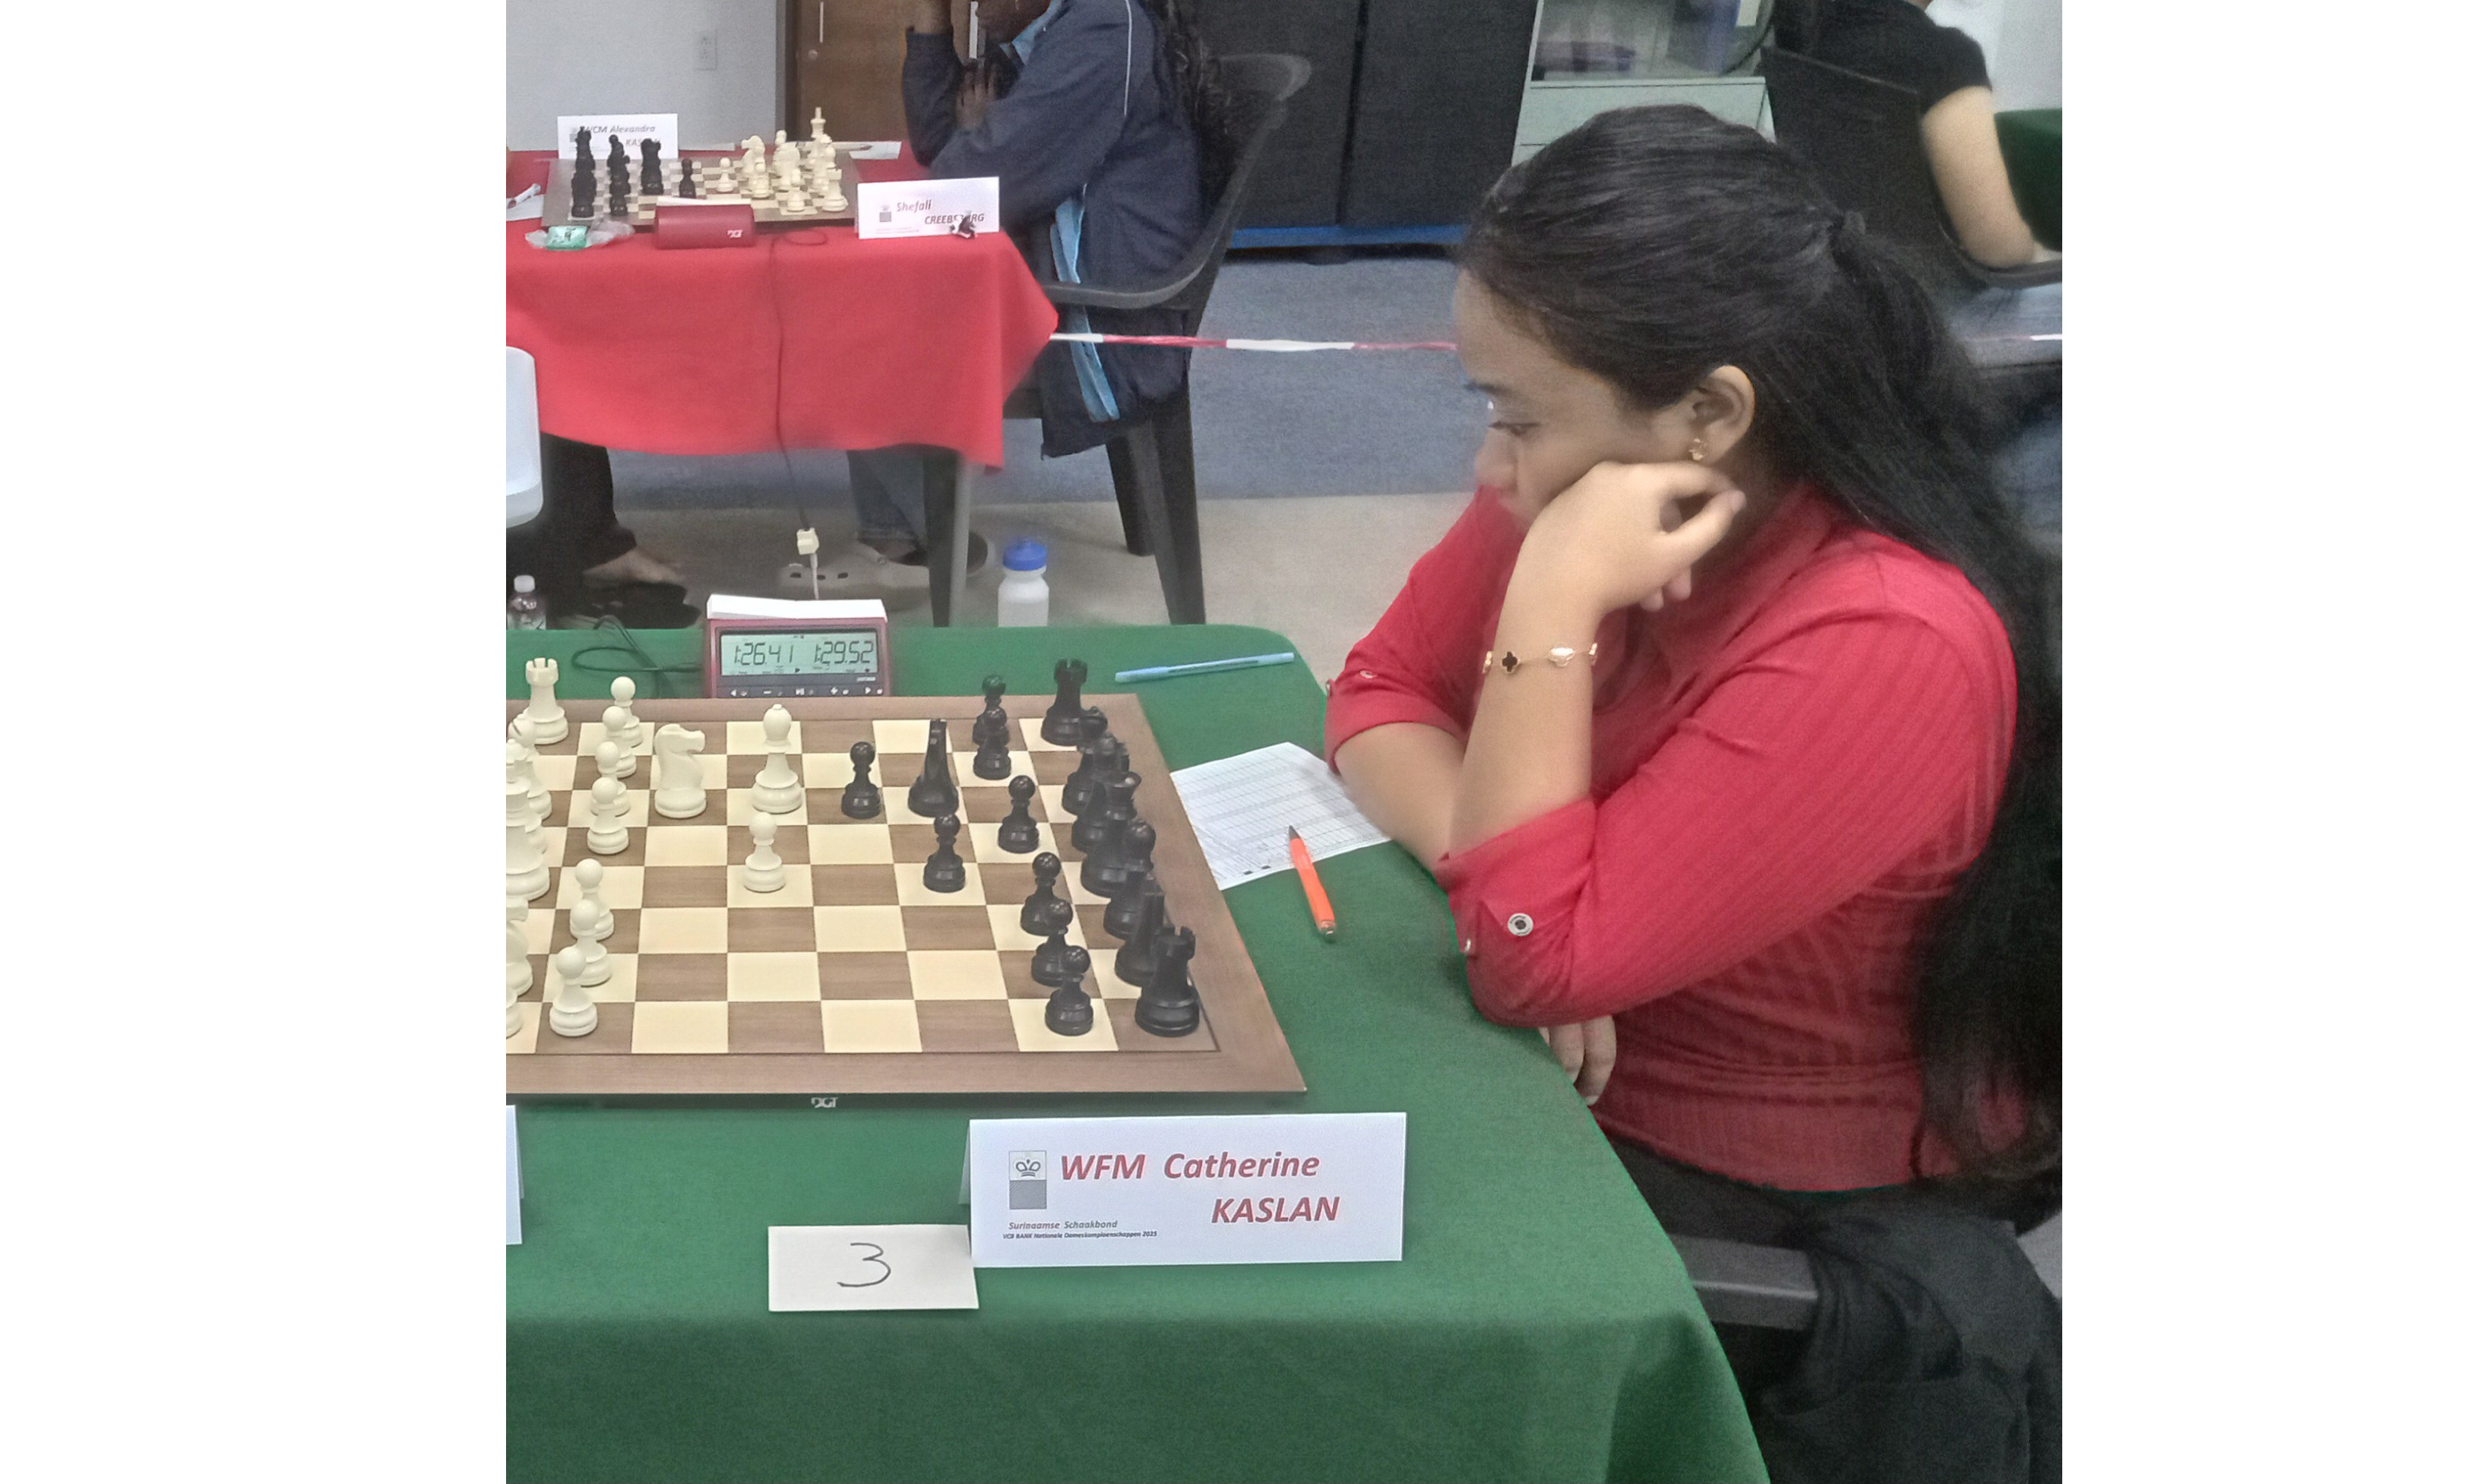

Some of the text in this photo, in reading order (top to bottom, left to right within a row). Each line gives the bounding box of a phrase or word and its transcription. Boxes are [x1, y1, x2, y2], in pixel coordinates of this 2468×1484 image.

[609, 125, 656, 134] Alexandra
[1061, 1151, 1320, 1180] WFM Catherine
[1210, 1196, 1340, 1223] KASLAN
[1008, 1220, 1118, 1229] Surinaamse Schaakbond
[837, 1242, 891, 1287] 3
